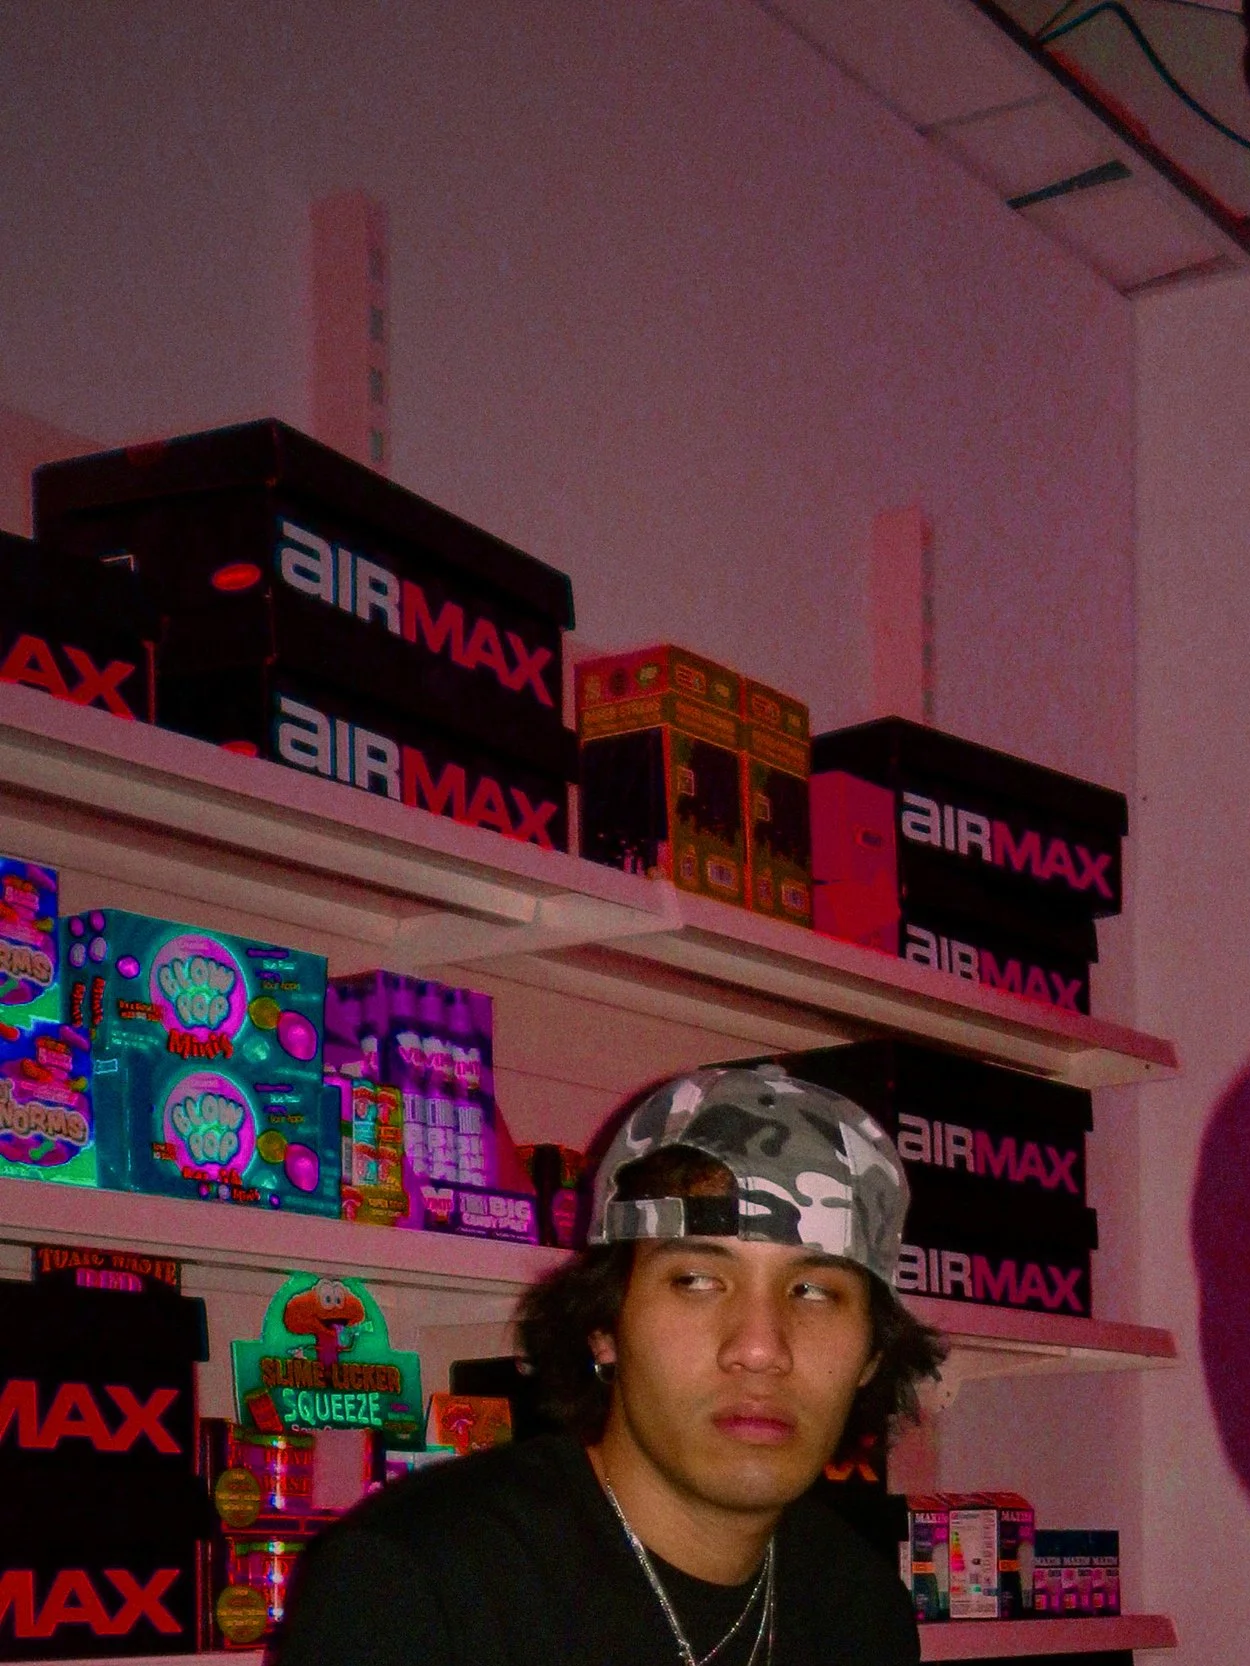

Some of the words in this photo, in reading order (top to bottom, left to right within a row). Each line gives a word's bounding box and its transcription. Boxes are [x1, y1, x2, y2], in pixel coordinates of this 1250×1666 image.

[159, 956, 235, 998] BLOW
[176, 994, 229, 1030] POP
[172, 1093, 245, 1135] BLOW
[188, 1131, 240, 1166] POP
[283, 1388, 383, 1426] SQUEEZE
